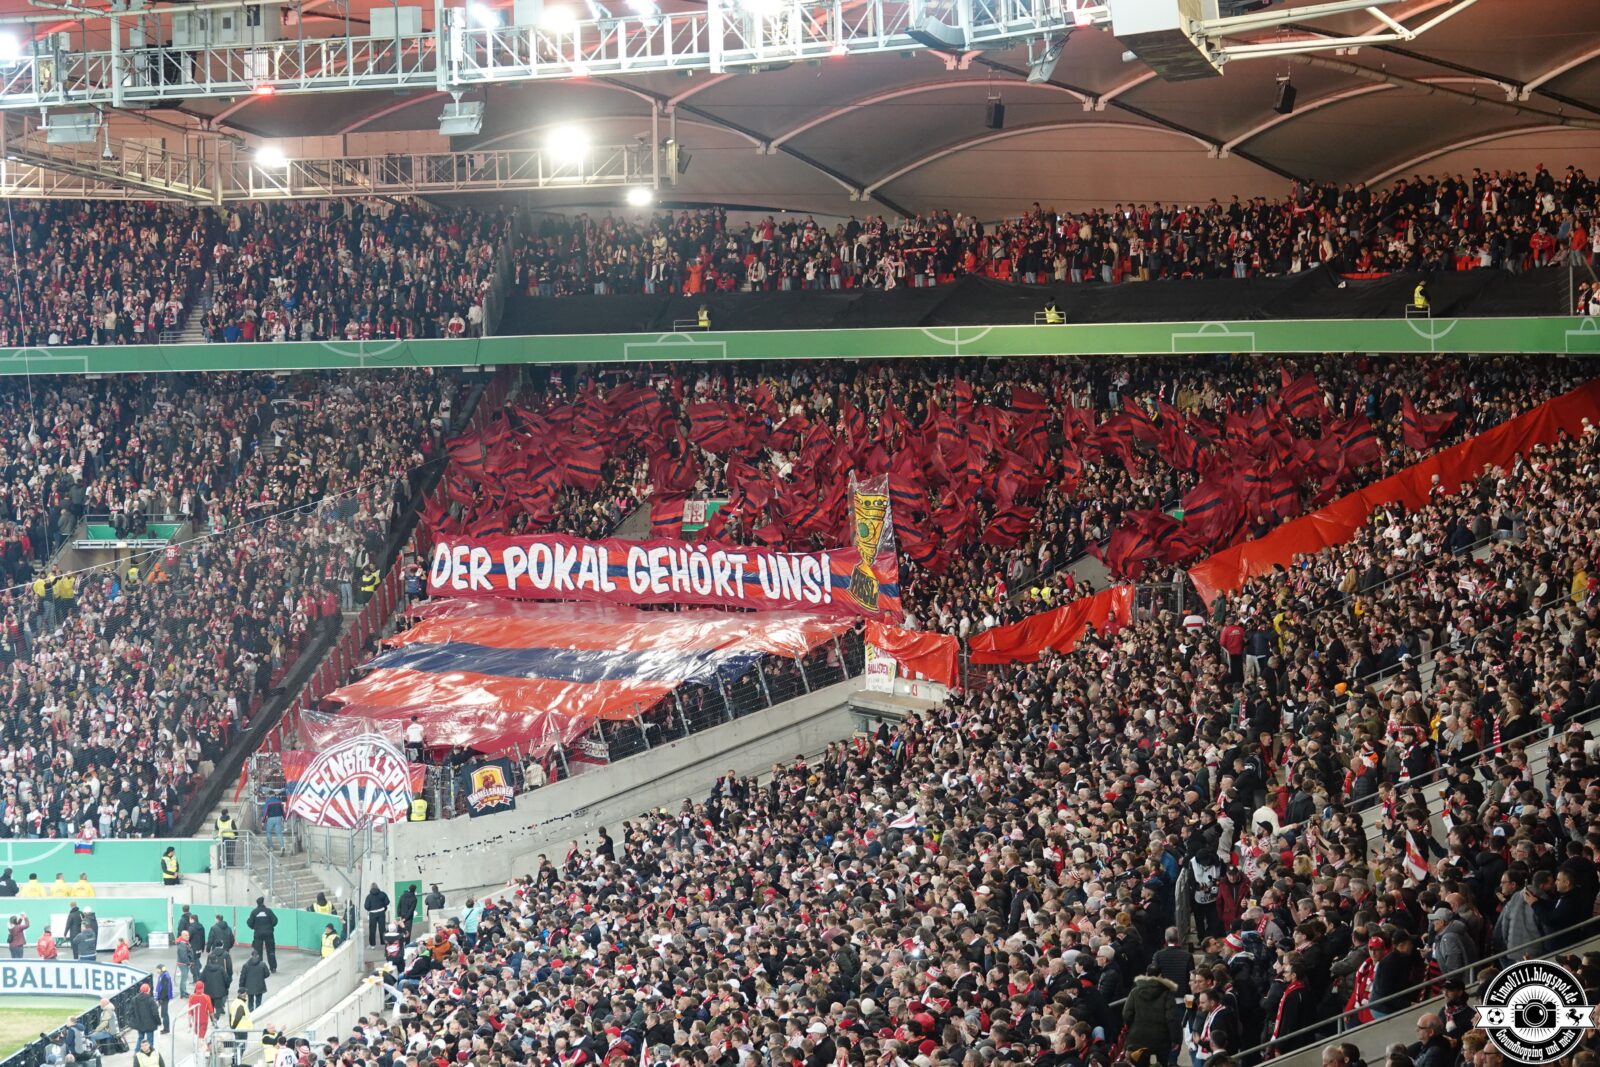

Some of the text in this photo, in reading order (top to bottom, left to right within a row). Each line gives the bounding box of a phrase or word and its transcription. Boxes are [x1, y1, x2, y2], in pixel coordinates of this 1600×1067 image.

[431, 542, 494, 591] DER
[503, 542, 617, 593] POKAL
[627, 543, 748, 599] GEHÖRT
[757, 552, 831, 604] UNS!
